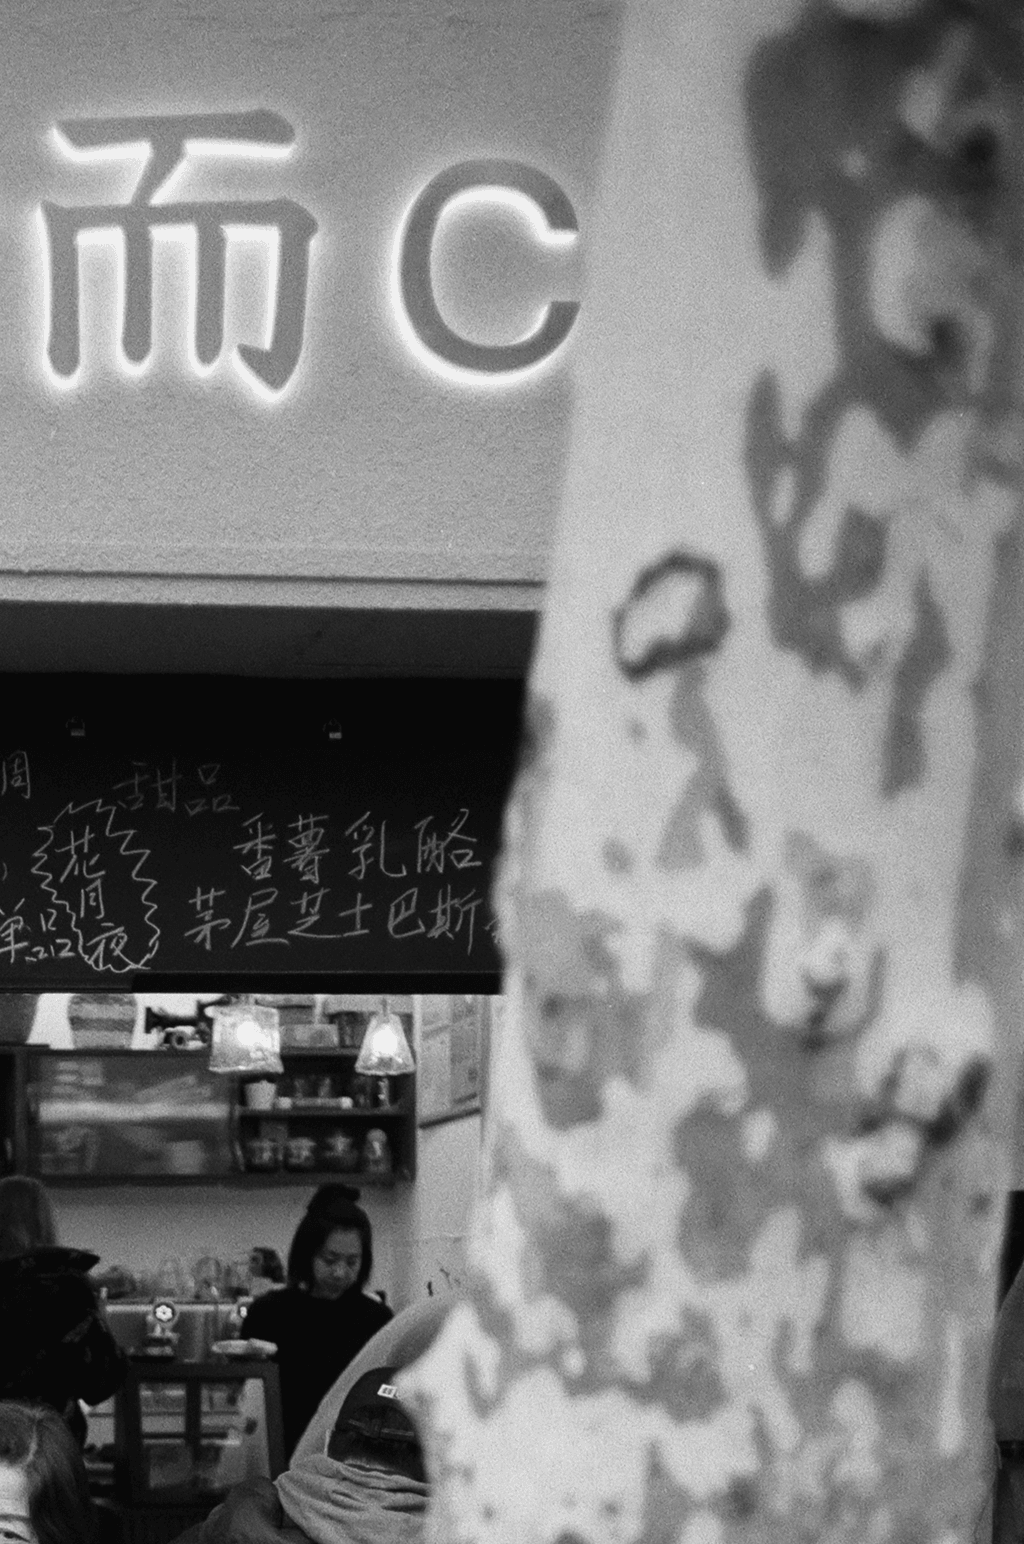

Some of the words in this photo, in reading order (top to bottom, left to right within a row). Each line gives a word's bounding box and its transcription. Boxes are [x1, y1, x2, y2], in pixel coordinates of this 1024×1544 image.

[112, 757, 240, 817] 甜品
[233, 808, 482, 884] 番薯乳酪
[184, 884, 500, 955] 茅屋芝士巴斯
